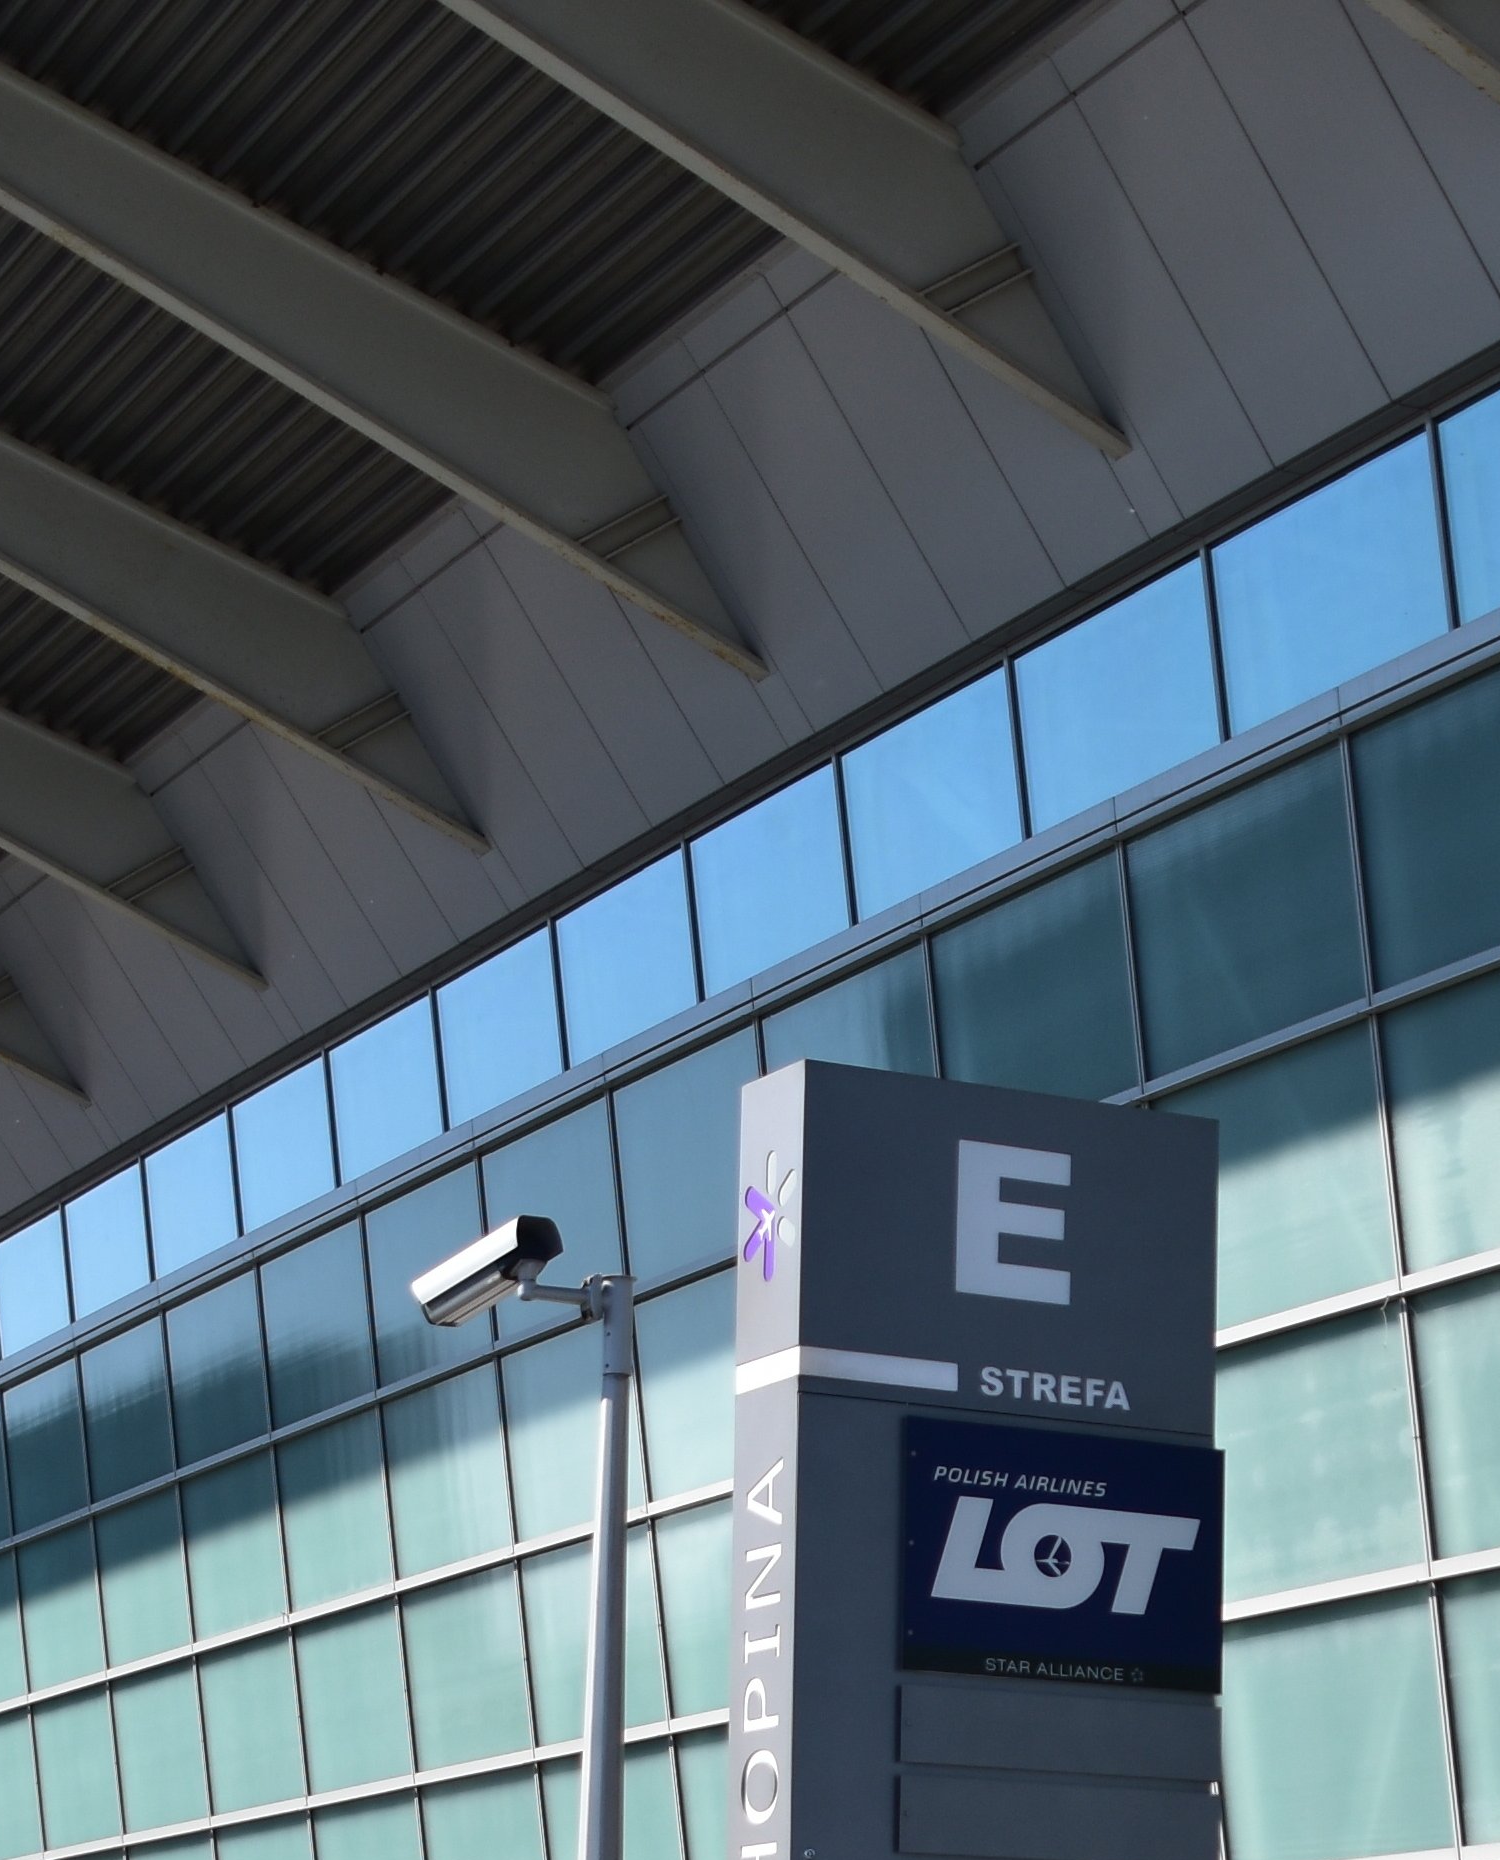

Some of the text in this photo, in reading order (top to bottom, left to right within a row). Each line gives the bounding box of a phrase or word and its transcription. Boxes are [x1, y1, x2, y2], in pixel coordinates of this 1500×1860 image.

[956, 1139, 1071, 1305] E
[980, 1366, 1131, 1411] STREFA
[933, 1465, 1108, 1497] POLISH AIRLINES
[931, 1496, 1200, 1615] LOT
[985, 1657, 1124, 1682] STAR ALLIANCE
